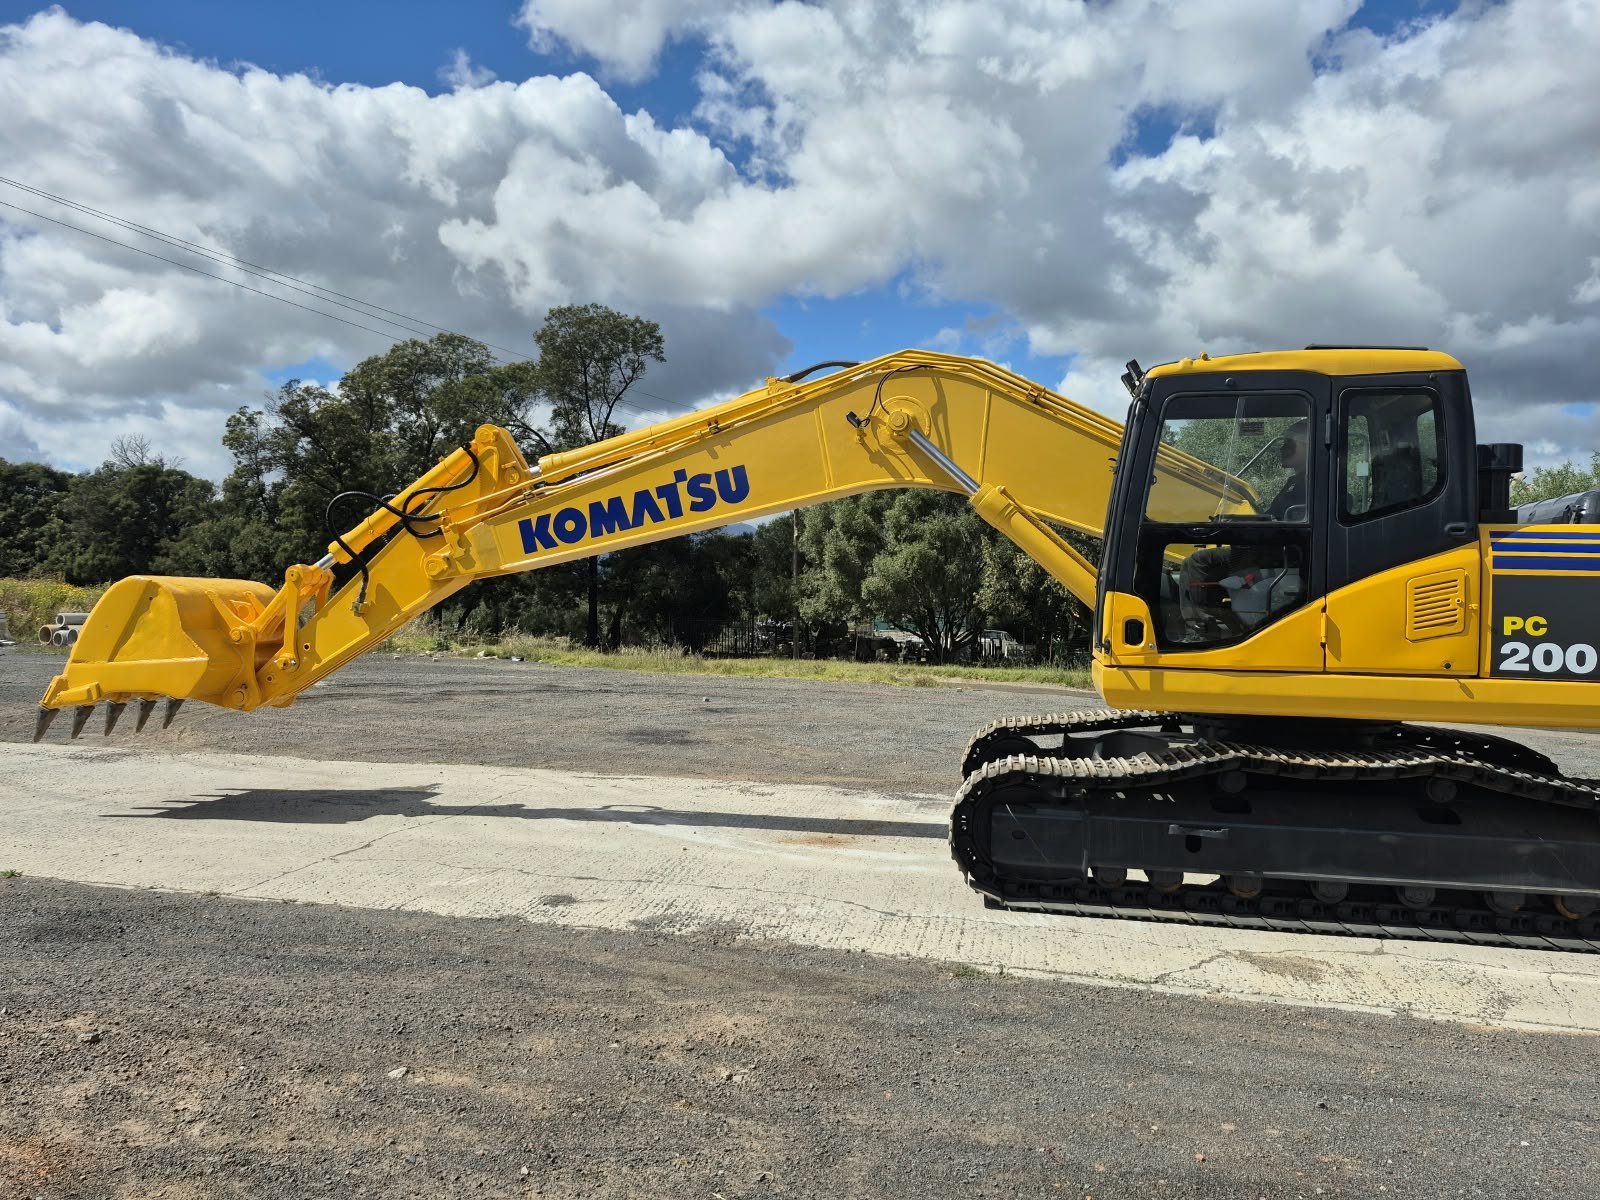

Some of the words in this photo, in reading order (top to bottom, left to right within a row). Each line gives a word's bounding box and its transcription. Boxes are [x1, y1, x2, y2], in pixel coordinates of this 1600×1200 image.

[518, 465, 750, 555] KOMATSU
[1503, 616, 1548, 636] PC
[1499, 641, 1598, 674] 200
